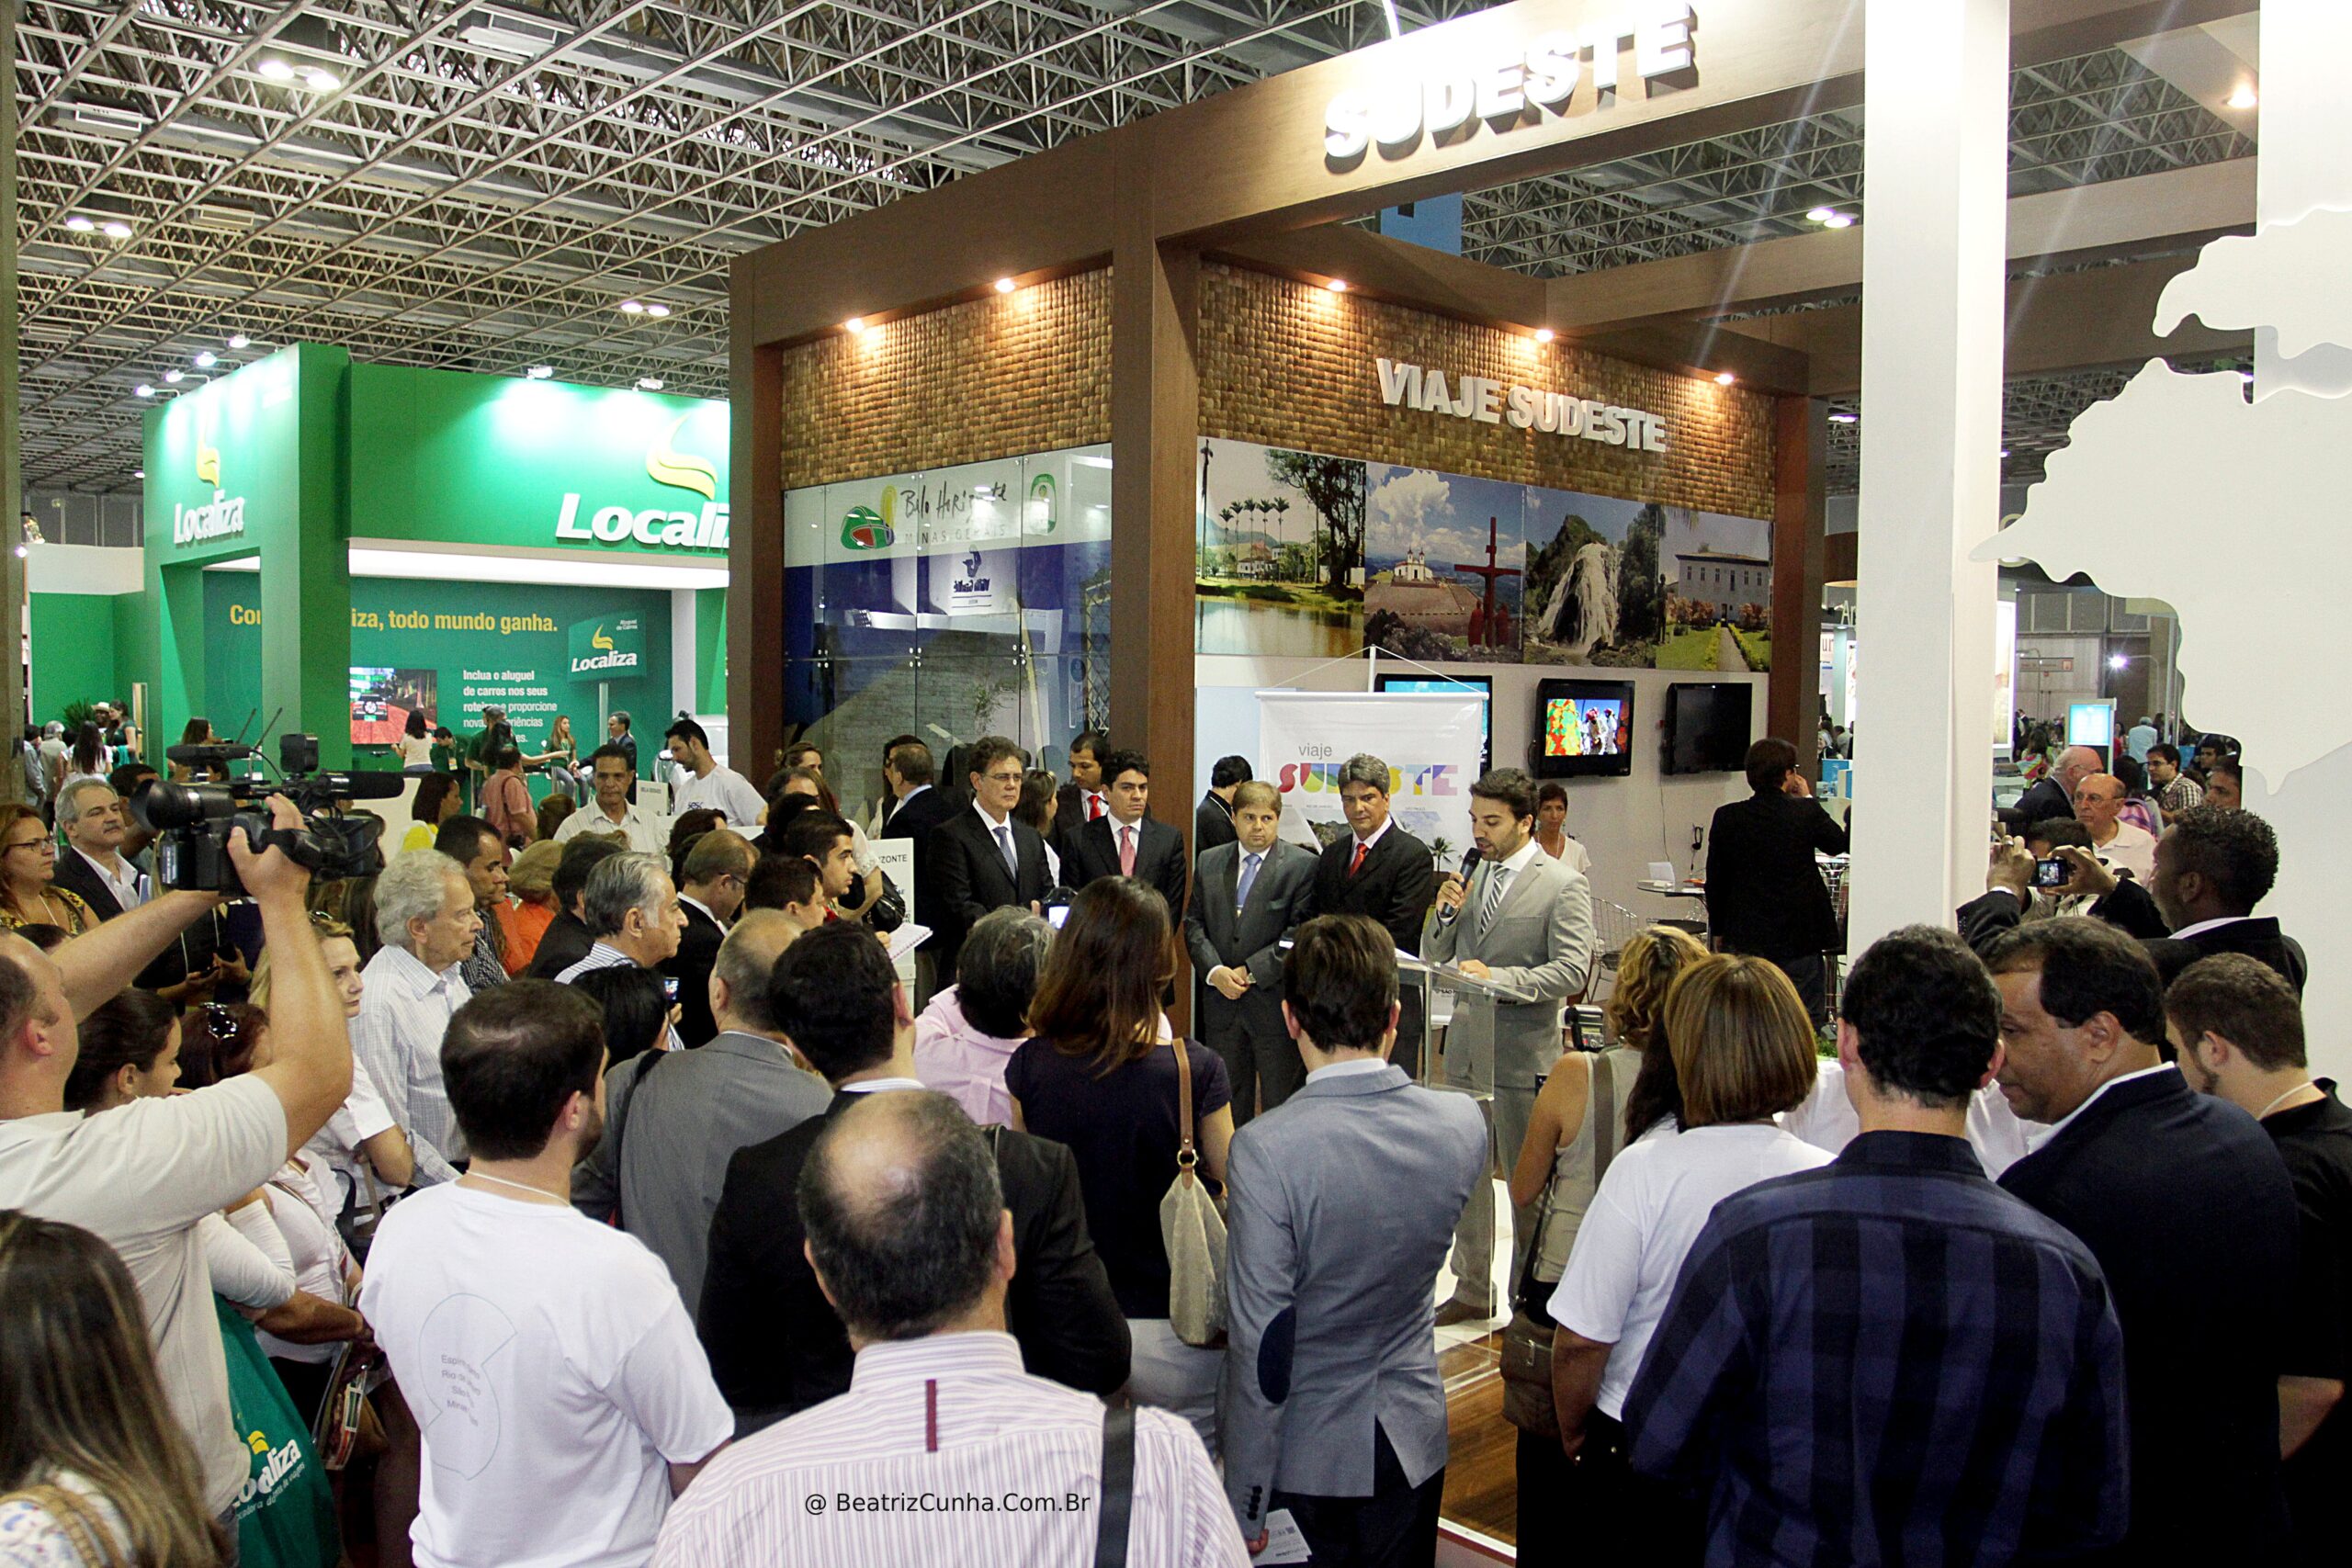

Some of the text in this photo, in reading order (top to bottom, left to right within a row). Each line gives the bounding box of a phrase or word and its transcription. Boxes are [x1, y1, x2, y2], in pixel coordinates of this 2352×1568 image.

[1324, 2, 1693, 158] SUDESTE
[1375, 358, 1668, 453] VIAJE SUDESTE
[174, 489, 245, 544] Localiza
[555, 492, 730, 548] Locali
[389, 610, 430, 629] todo
[435, 613, 496, 630] mundo
[500, 614, 559, 635] ganha.
[571, 650, 638, 672] Localiza
[463, 670, 535, 683] Inclua o aluguel
[463, 686, 548, 696] de carros nos seus
[508, 702, 558, 714] proporcione
[1298, 743, 1333, 761] viaje
[877, 854, 908, 863] ZONTE
[232, 1439, 301, 1508] oaliza
